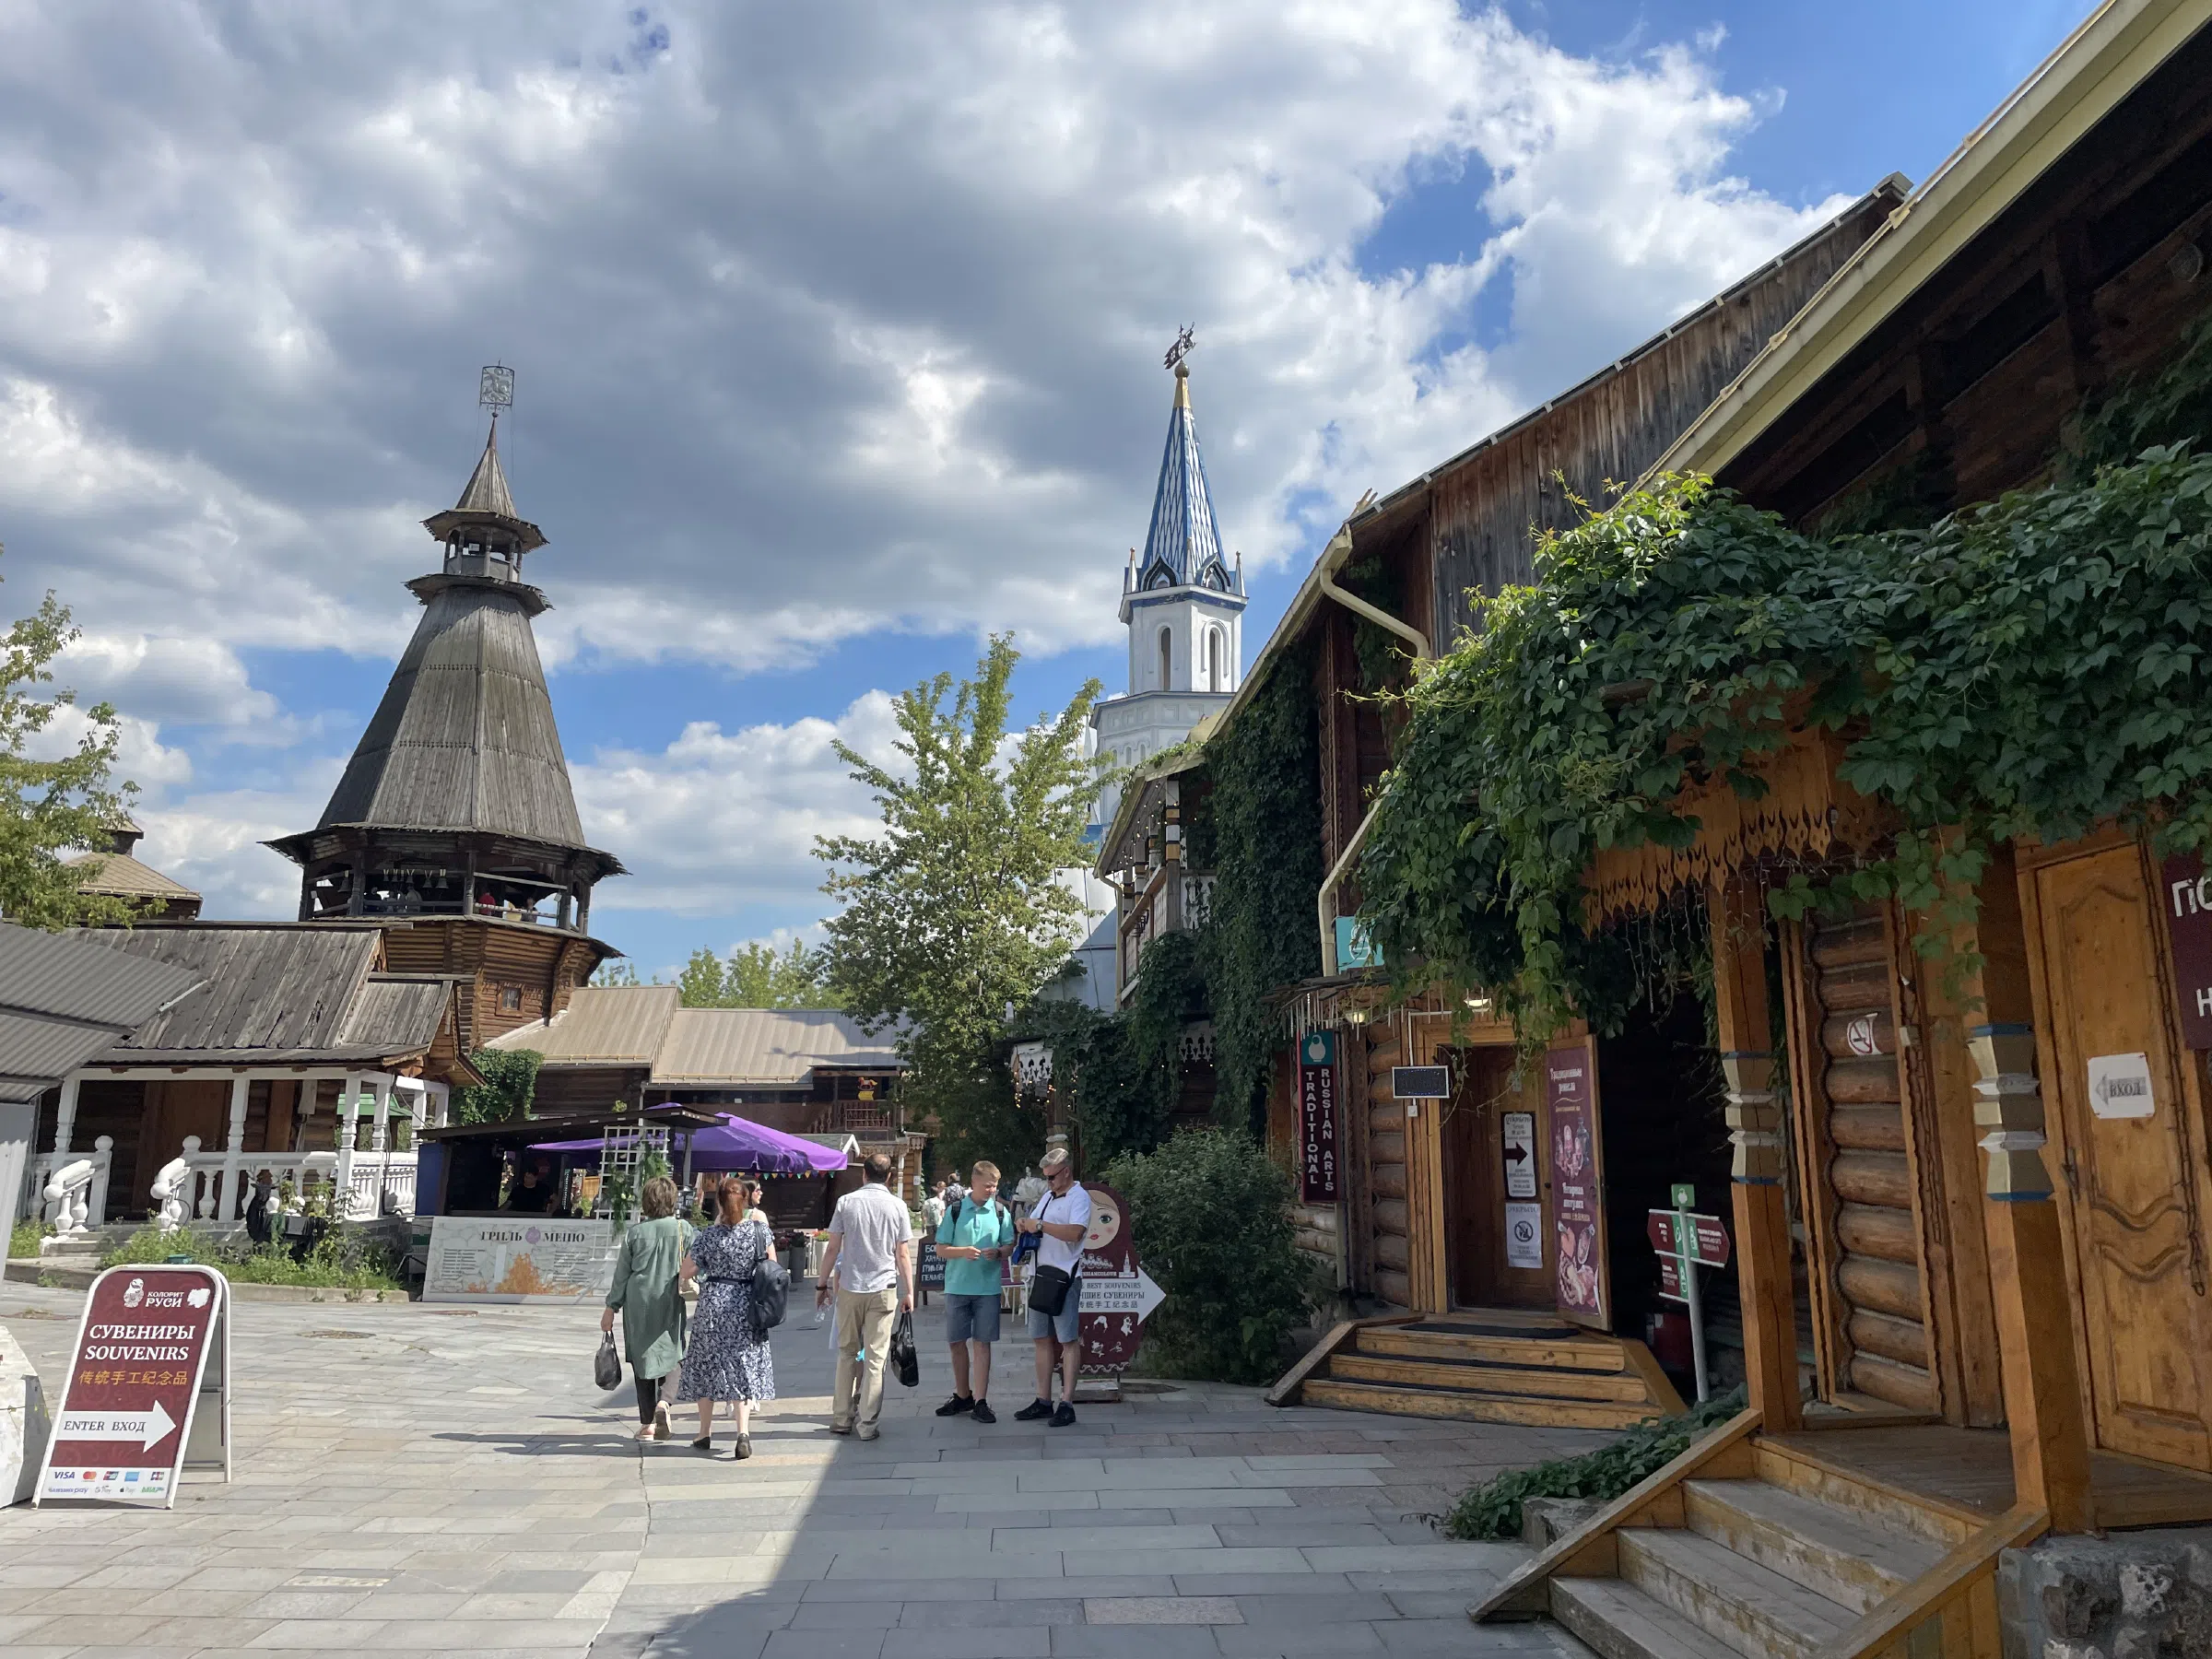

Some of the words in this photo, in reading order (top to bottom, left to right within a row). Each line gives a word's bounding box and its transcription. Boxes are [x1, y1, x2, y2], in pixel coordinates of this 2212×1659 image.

[2109, 1082, 2142, 1098] ВХОД
[1321, 1068, 1333, 1140] RUSSIAN
[1306, 1072, 1319, 1184] TRADITIONAL
[1324, 1150, 1334, 1192] ARTS
[480, 1231, 522, 1242] ГРИЛЬ
[542, 1232, 585, 1242] МЕНЮ
[1103, 1291, 1145, 1300] СУВЕНИРЫ
[145, 1298, 184, 1308] РУСИ
[89, 1325, 195, 1340] СУВЕНИРЫ
[85, 1347, 189, 1360] SOUVENIRS
[78, 1371, 188, 1385] 传统手工纪念品
[64, 1420, 105, 1431] ENTER
[112, 1420, 147, 1433] ВХОД
[54, 1471, 76, 1479] VISA
